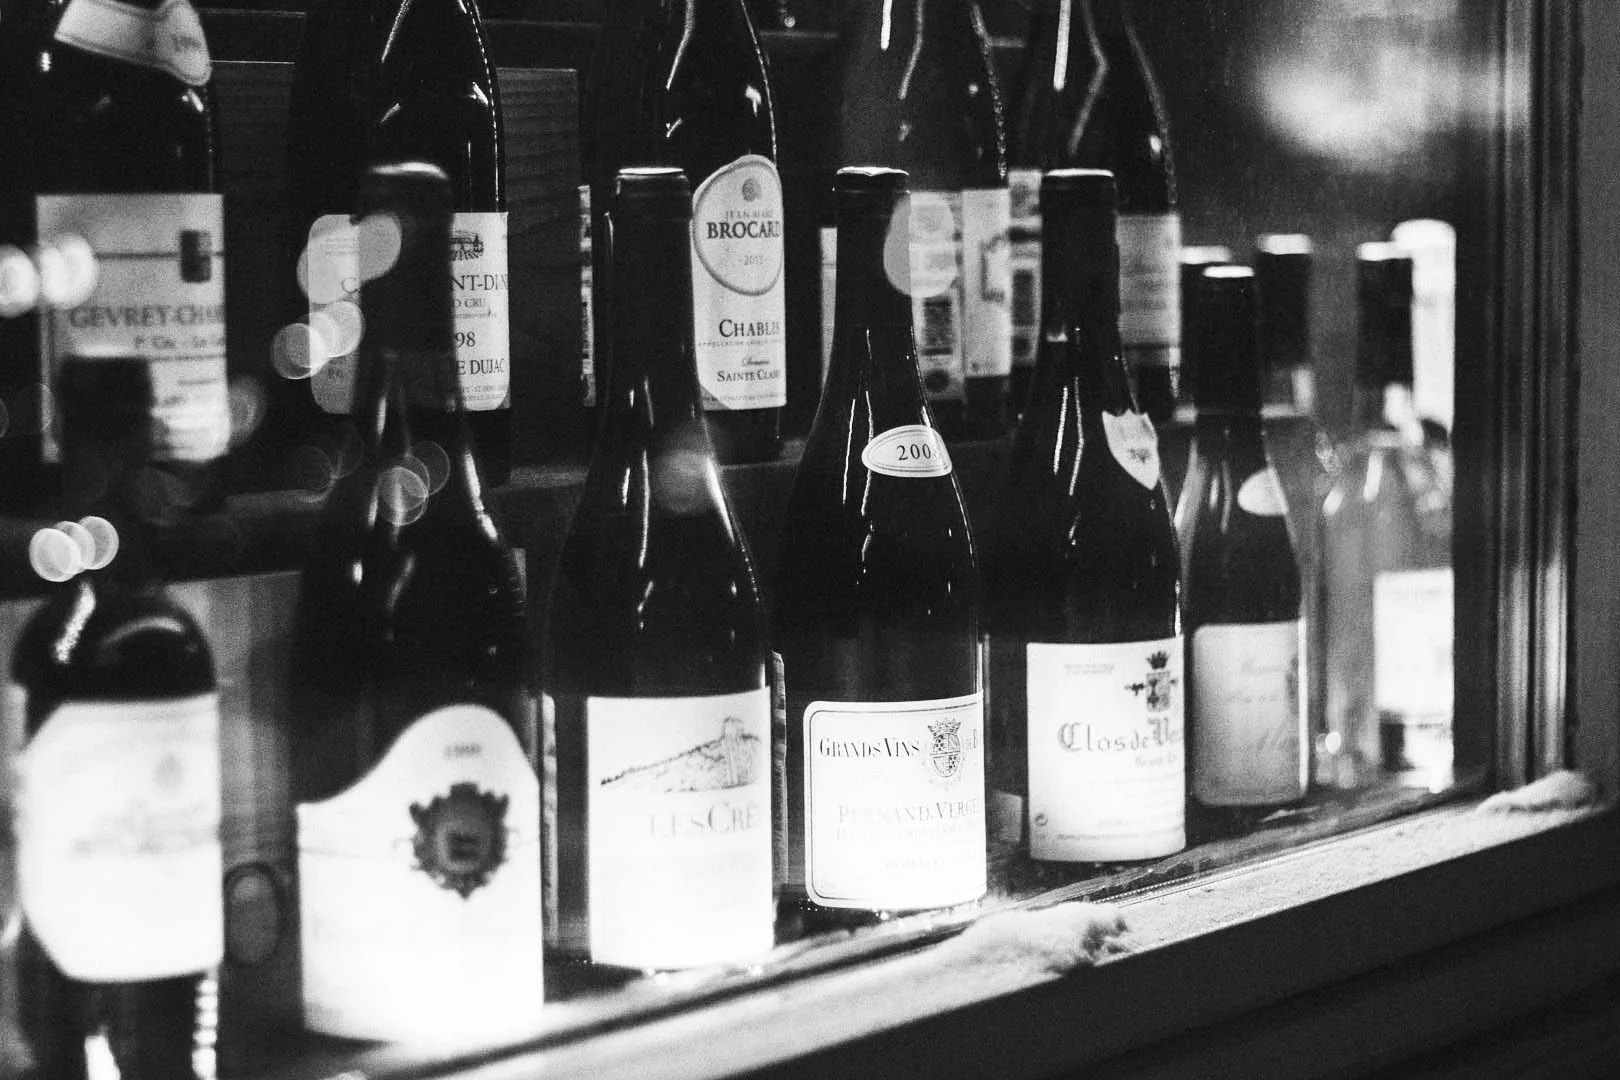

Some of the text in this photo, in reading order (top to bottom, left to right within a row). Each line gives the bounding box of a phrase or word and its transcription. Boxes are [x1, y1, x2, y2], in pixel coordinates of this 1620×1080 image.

[455, 331, 477, 349] 98
[470, 358, 504, 375] DUJAC
[716, 370, 756, 383] SAINTE
[896, 443, 938, 462] 200
[1056, 721, 1128, 752] Clos
[819, 736, 921, 759] GRANDS VINS
[706, 798, 763, 835] CRÊ
